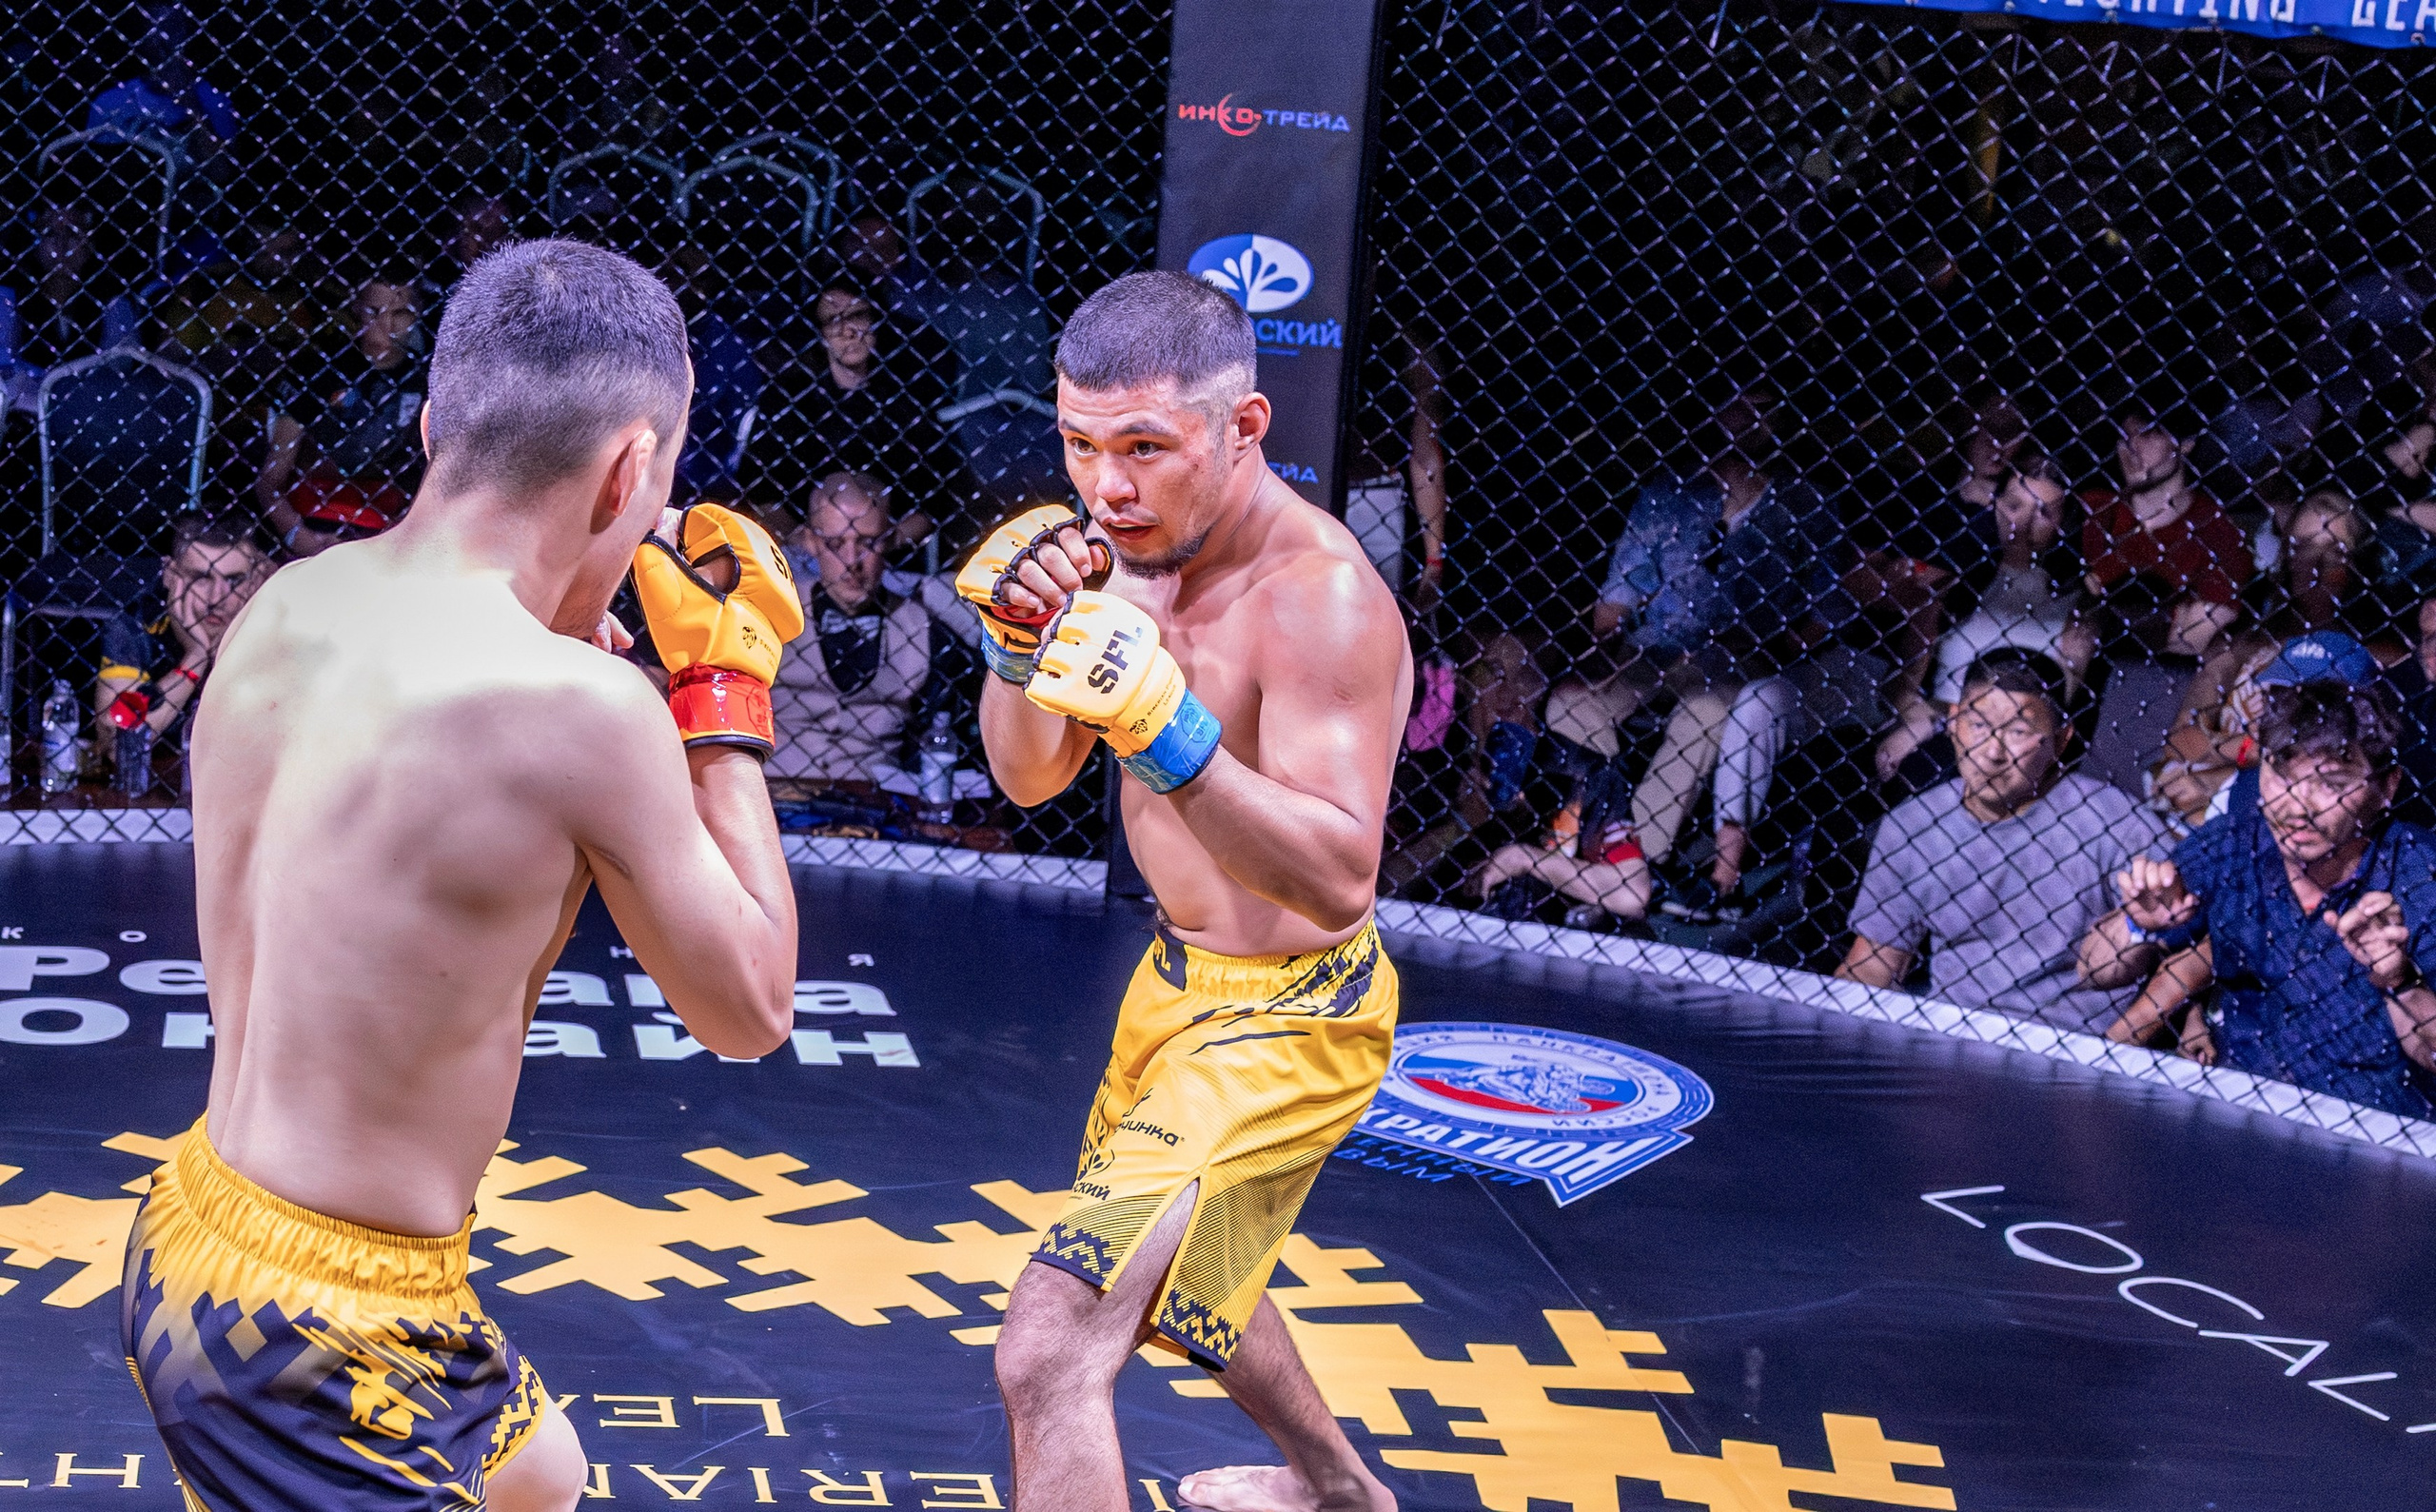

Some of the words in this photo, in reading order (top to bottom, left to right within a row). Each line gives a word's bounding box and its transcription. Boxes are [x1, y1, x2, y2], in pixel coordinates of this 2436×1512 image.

[1250, 317, 1342, 348] СКИЙ
[1088, 626, 1143, 694] SFL
[1358, 1105, 1663, 1184] КРАТИОН
[1920, 1185, 2436, 1433] LOCAL
